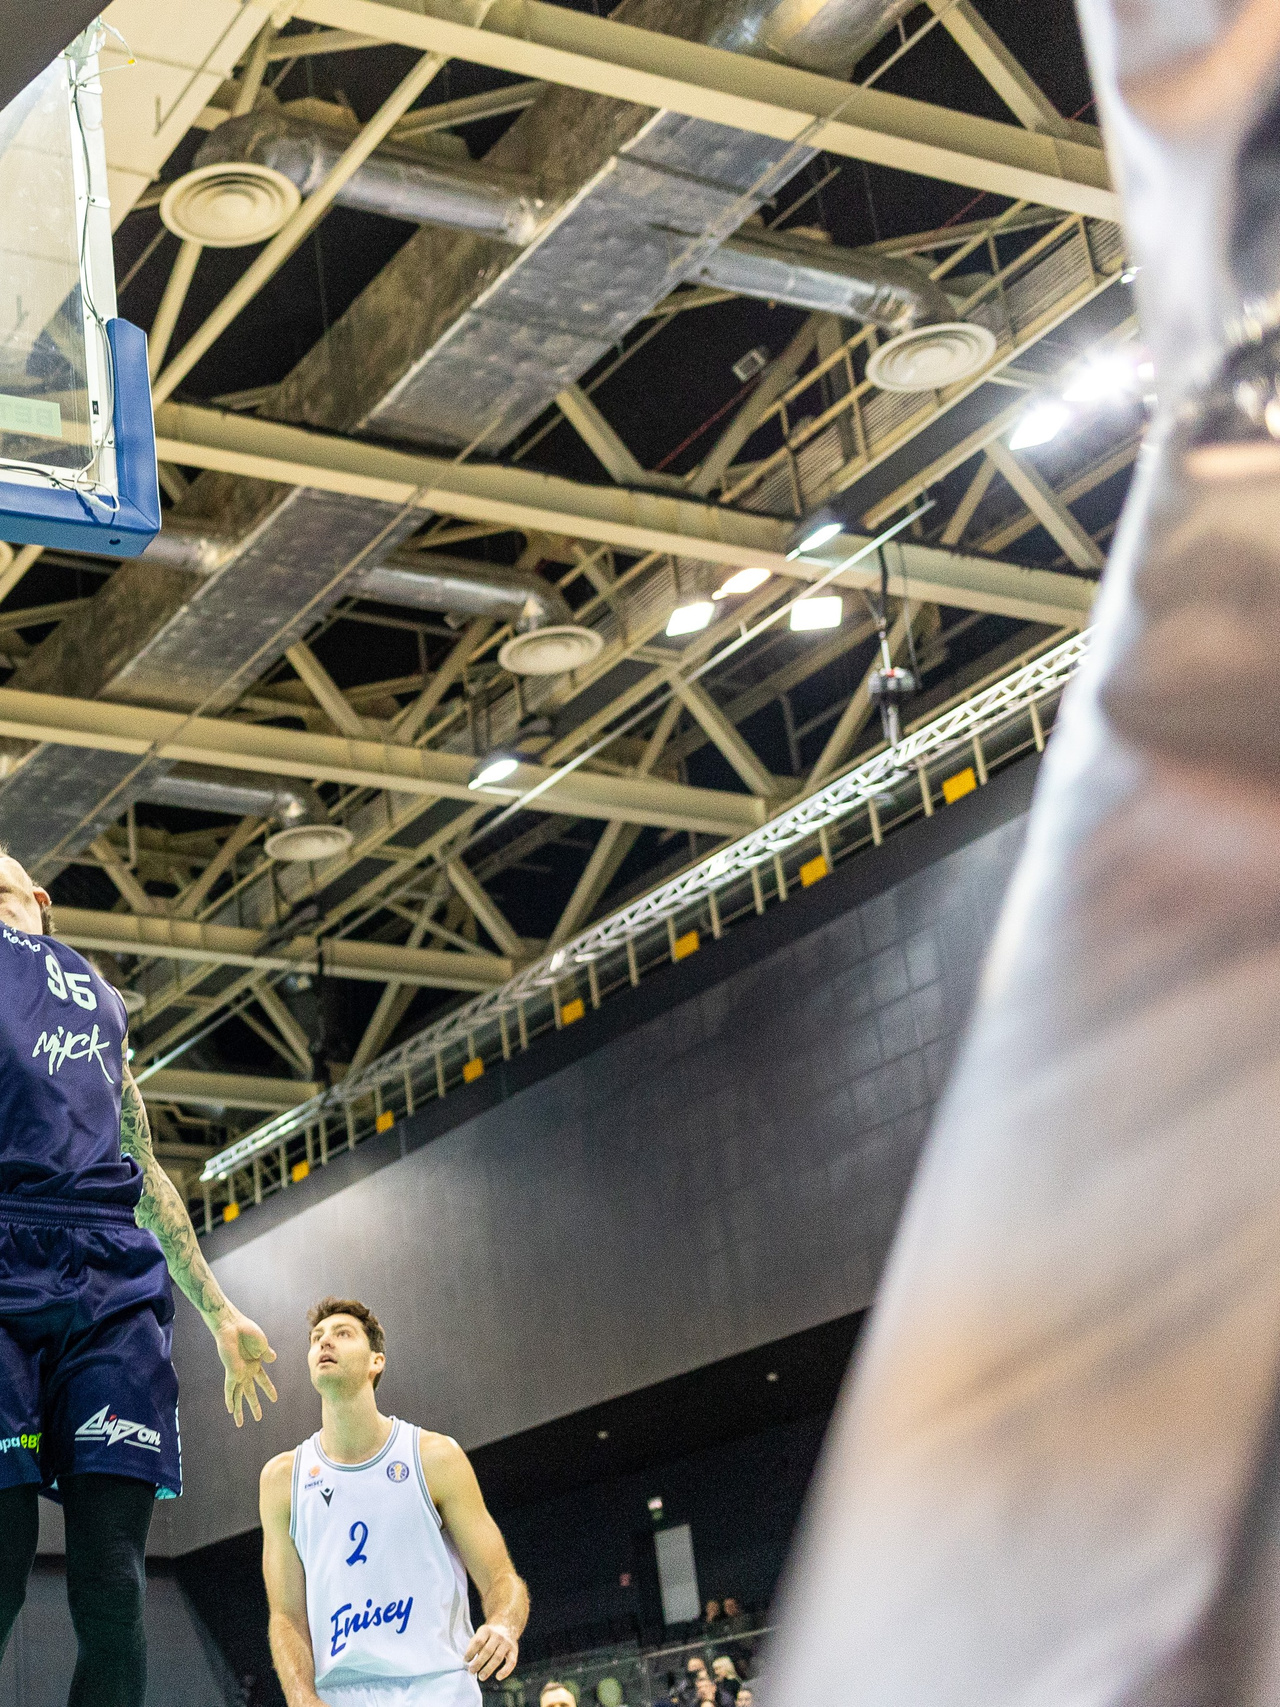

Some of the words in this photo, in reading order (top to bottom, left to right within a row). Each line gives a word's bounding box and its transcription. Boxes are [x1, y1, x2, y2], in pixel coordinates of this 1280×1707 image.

[45, 954, 97, 1011] 95
[345, 1520, 369, 1567] 2
[330, 1596, 414, 1657] Enisey
